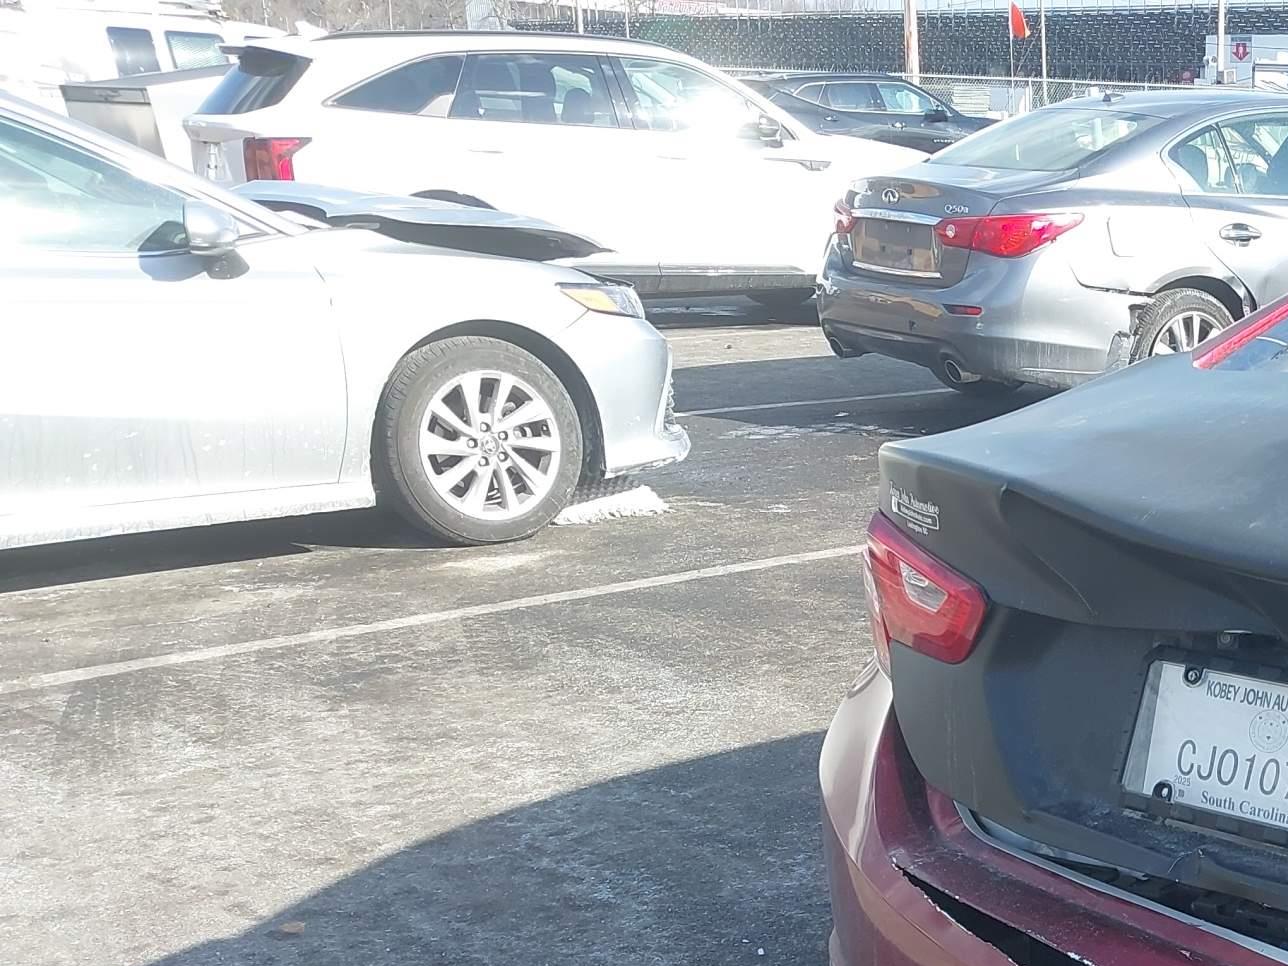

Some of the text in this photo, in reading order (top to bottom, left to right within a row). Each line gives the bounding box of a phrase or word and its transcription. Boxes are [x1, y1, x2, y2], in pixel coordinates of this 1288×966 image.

[1206, 680, 1241, 702] KOBEY
[1240, 687, 1272, 708] JOHN
[1201, 790, 1235, 811] South
